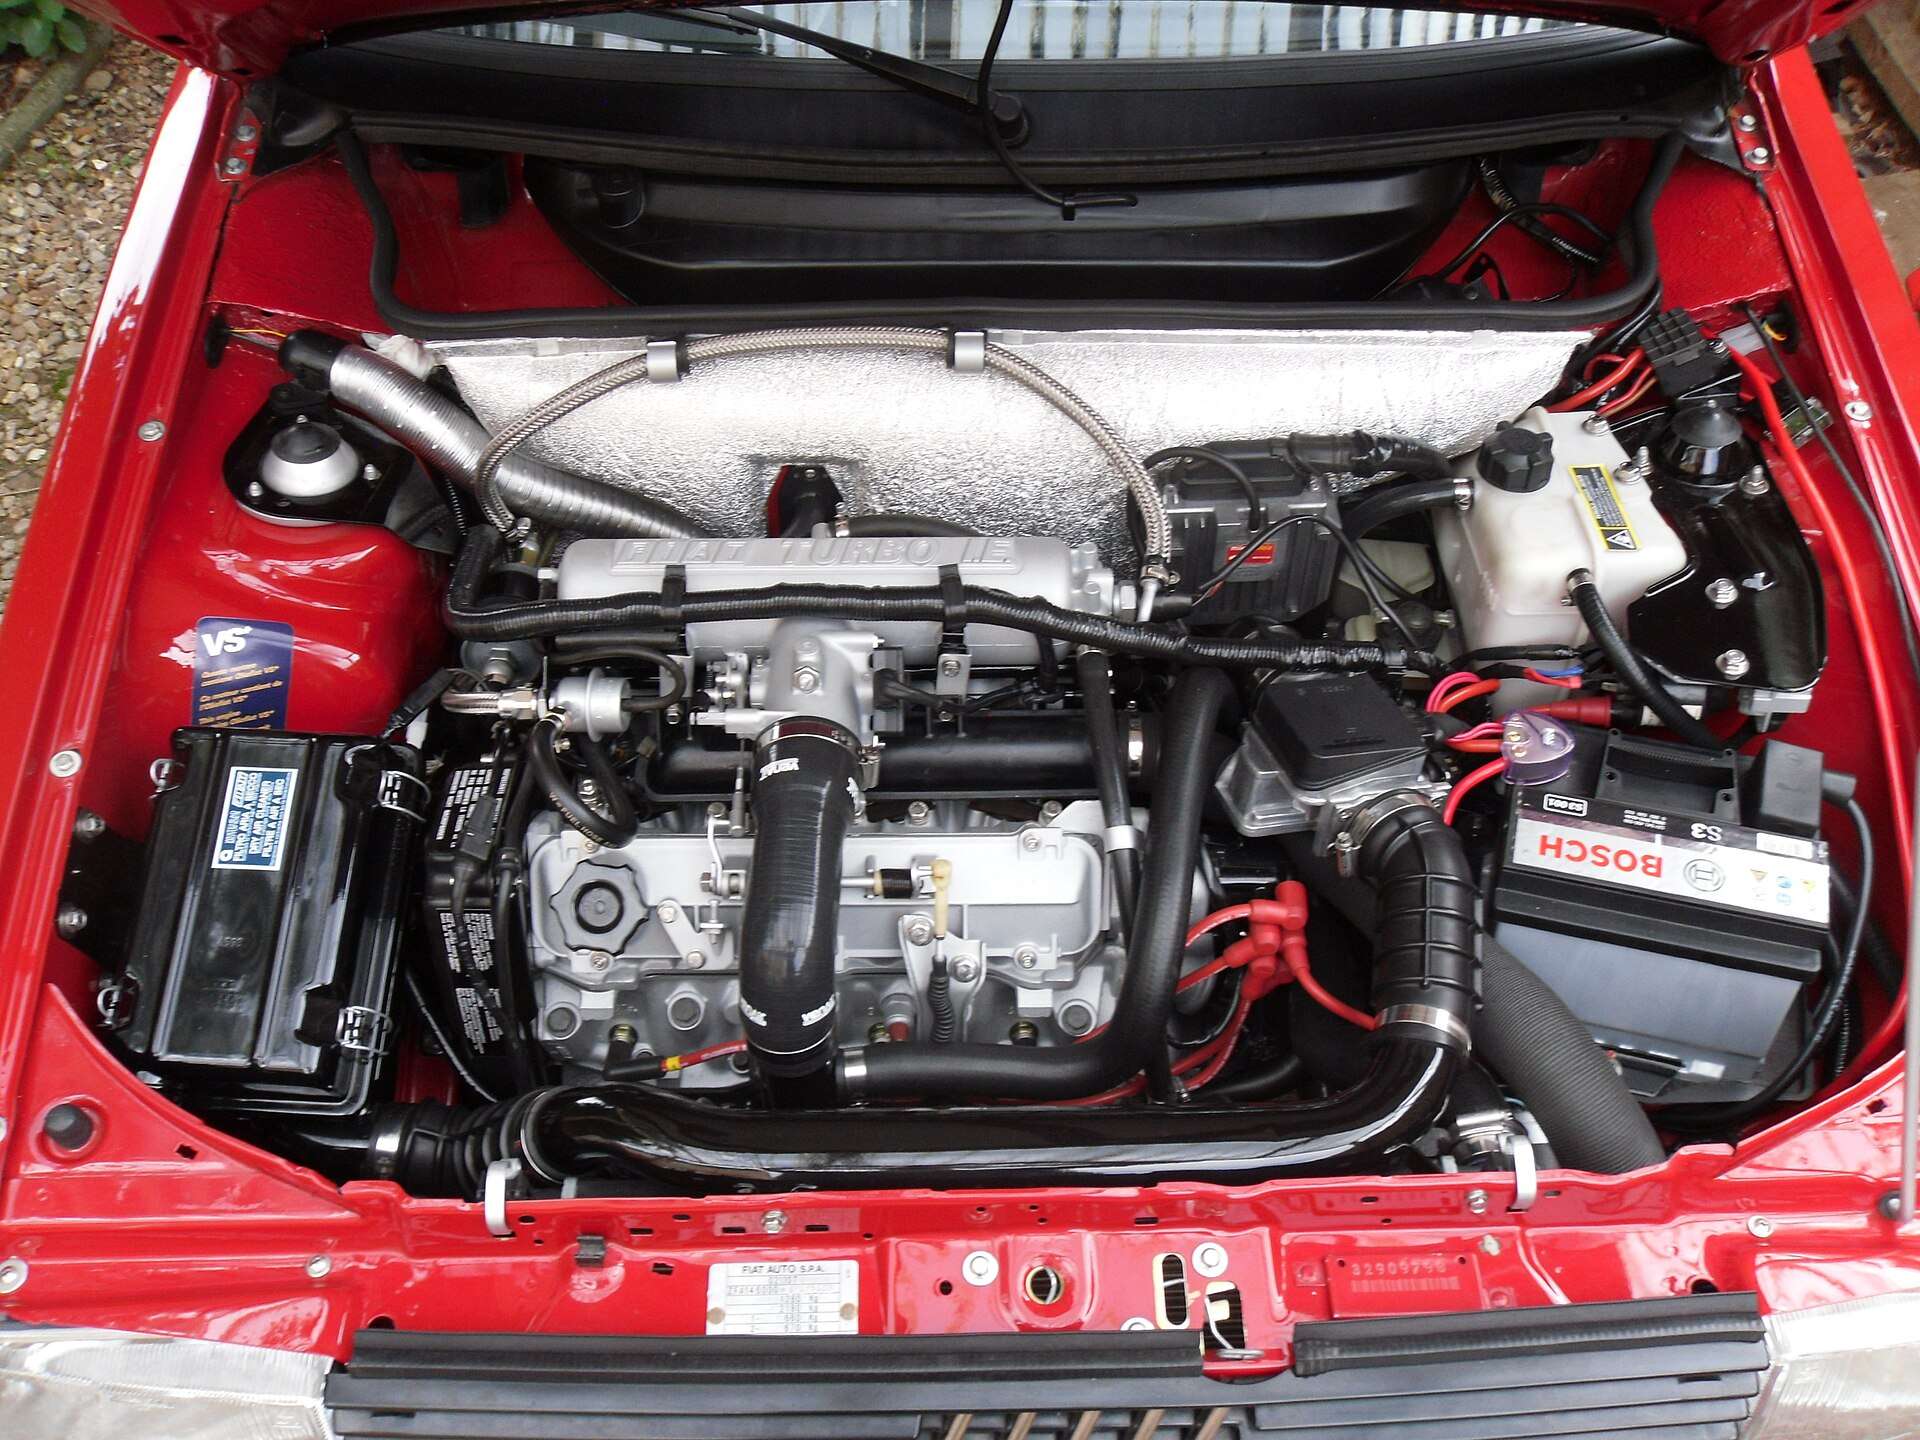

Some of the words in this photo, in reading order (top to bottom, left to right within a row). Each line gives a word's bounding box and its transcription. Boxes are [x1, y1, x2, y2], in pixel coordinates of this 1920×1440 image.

[626, 539, 747, 564] FIAT
[780, 539, 942, 564] TURBO
[1690, 822, 1722, 842] S3
[1539, 835, 1662, 878] BOSCH
[742, 1265, 764, 1274] FIAT
[768, 1264, 796, 1274] AUTO
